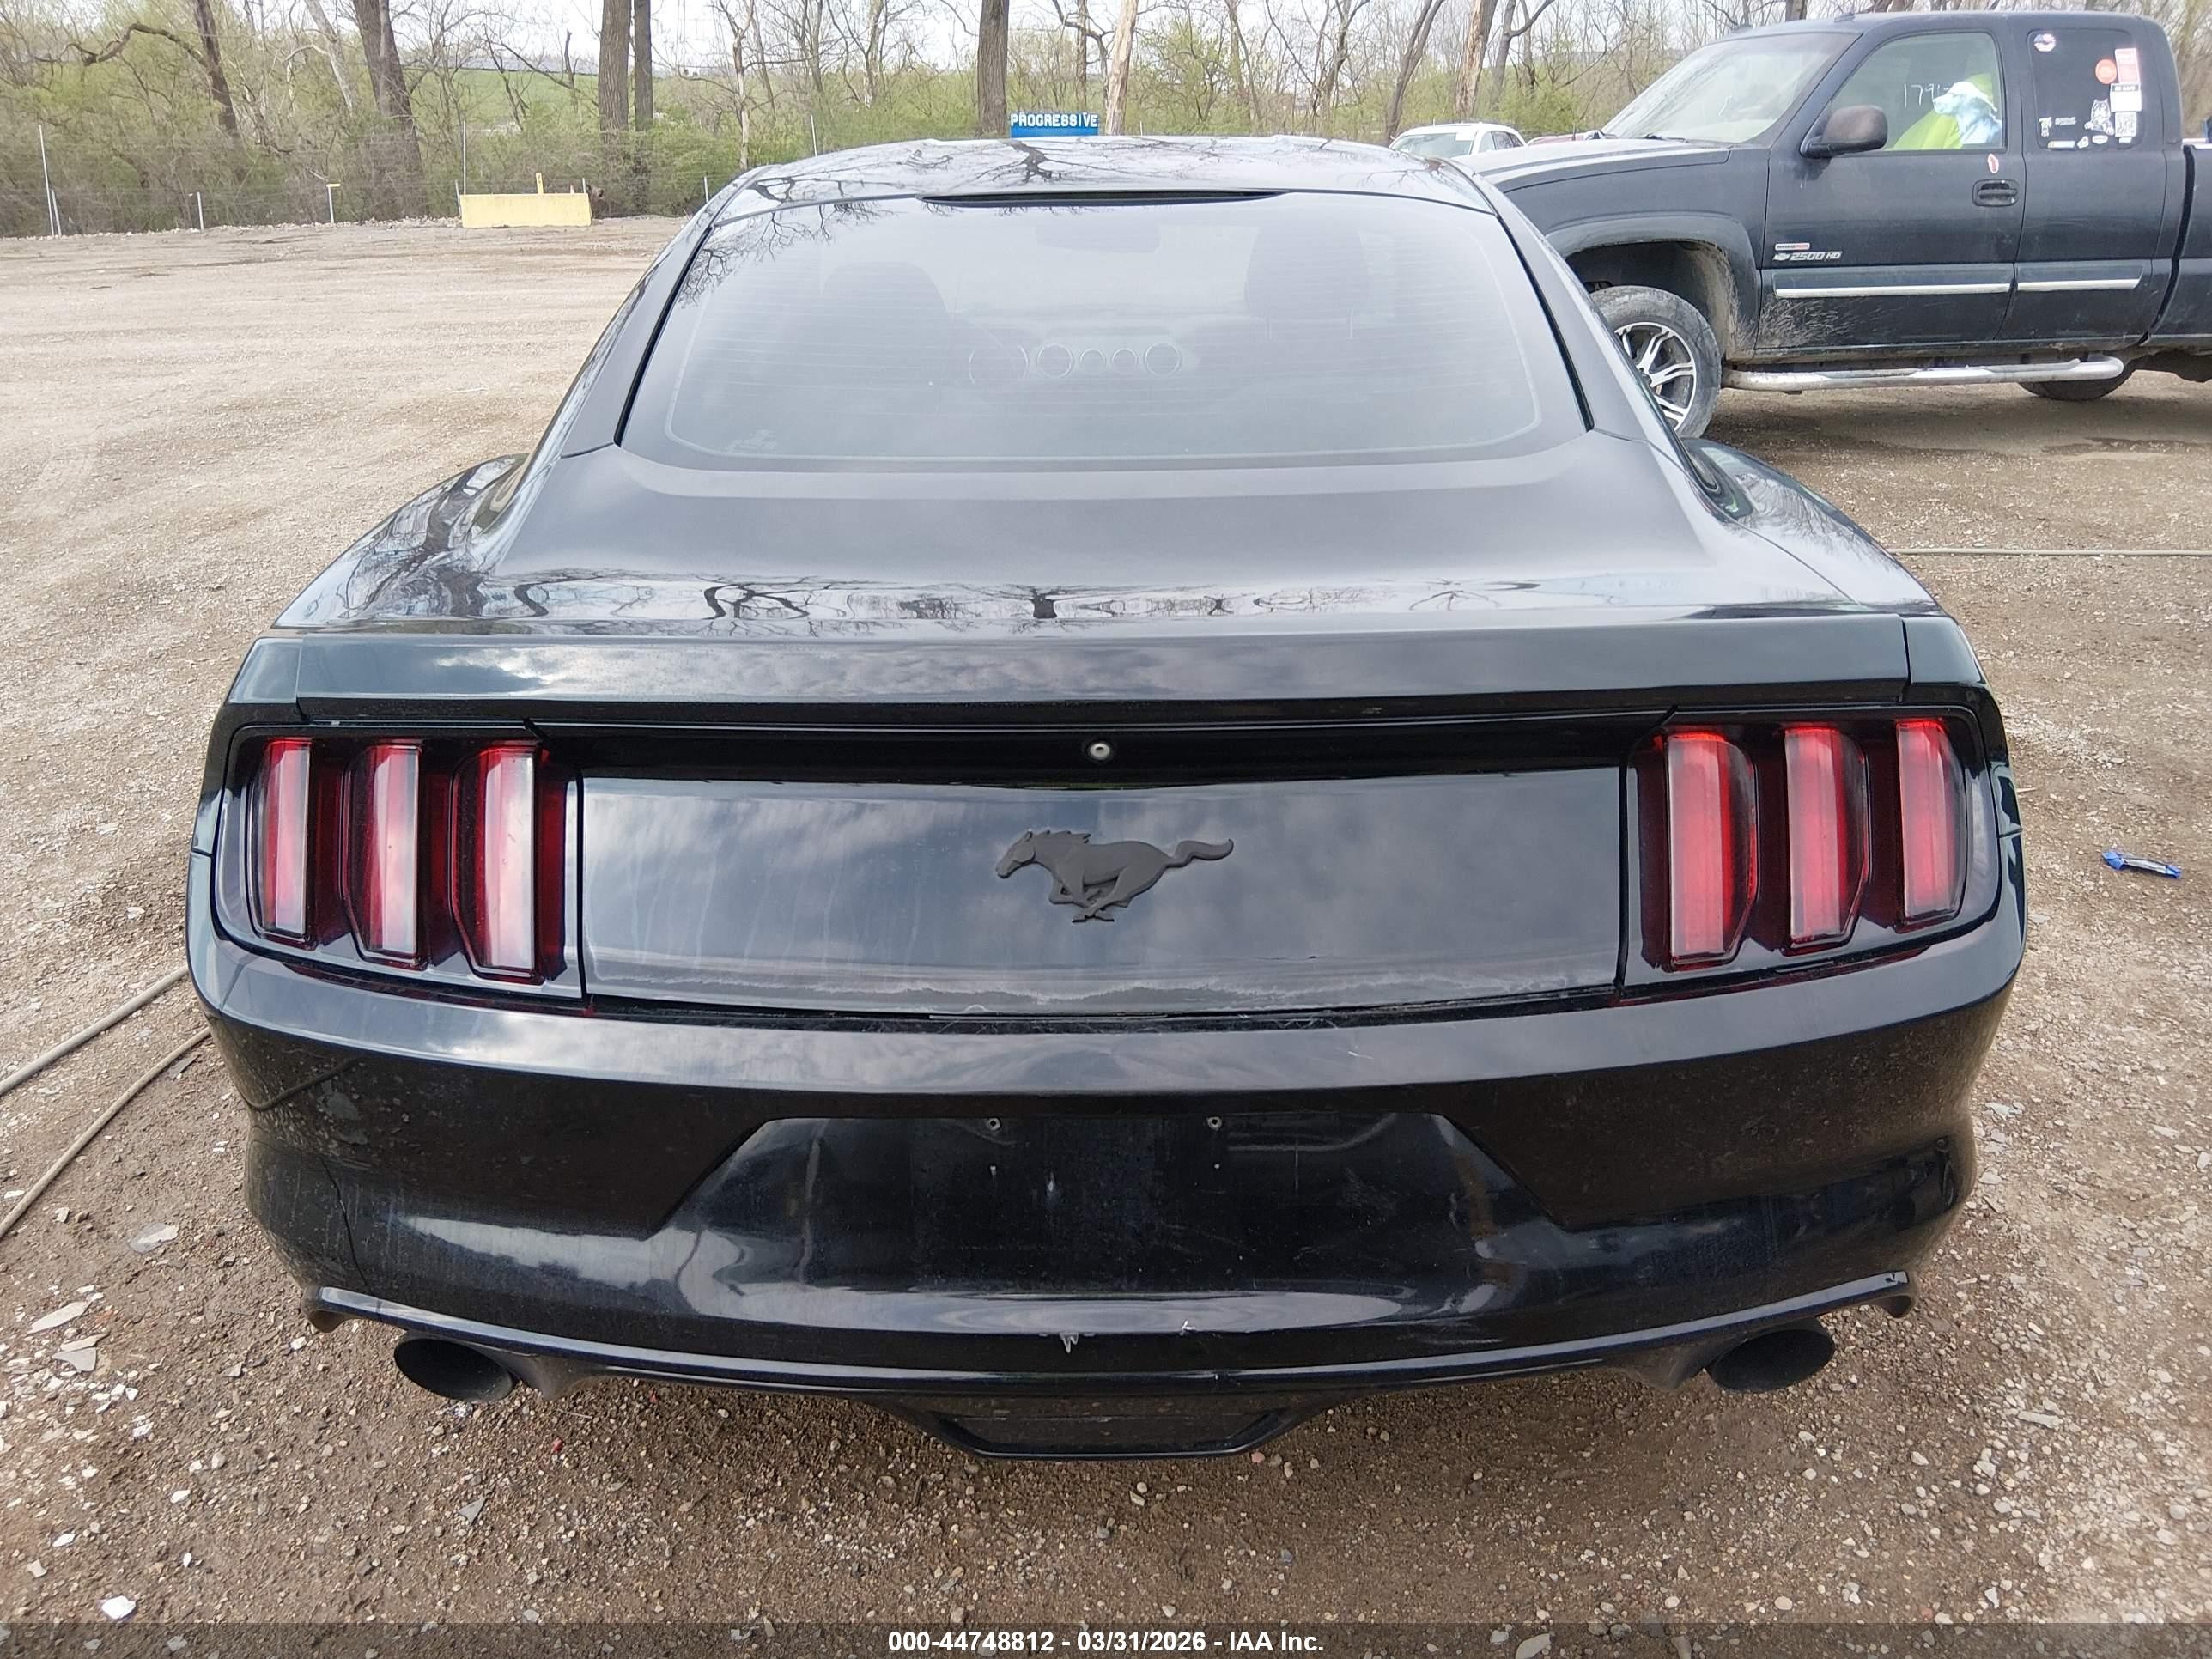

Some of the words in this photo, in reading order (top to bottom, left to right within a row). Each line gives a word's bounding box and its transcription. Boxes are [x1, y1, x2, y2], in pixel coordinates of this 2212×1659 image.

[1010, 112, 1098, 127] PROGRESSIVE
[1790, 251, 1826, 261] 2500
[1826, 251, 1843, 259] HD
